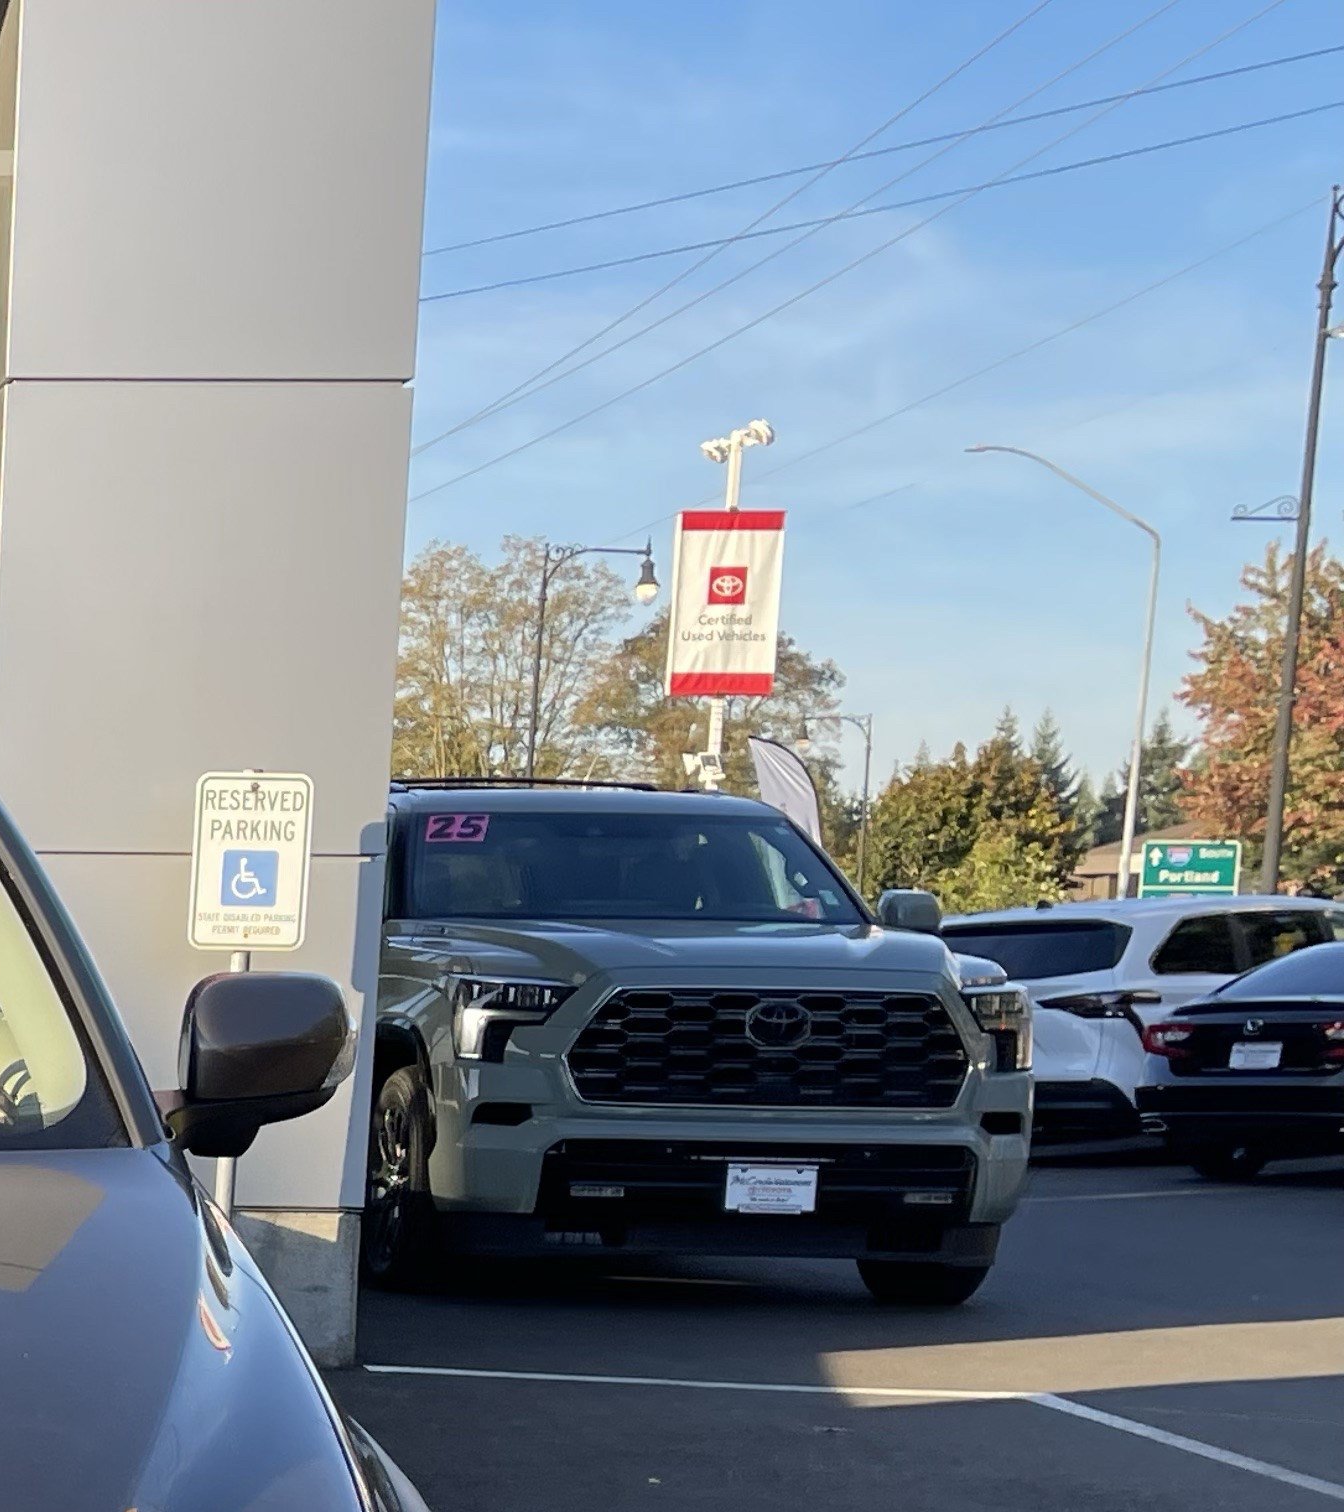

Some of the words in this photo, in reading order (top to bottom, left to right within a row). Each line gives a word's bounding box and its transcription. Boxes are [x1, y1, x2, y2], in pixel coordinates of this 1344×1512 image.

[698, 613, 753, 626] Certified
[681, 630, 714, 641] Used
[717, 630, 767, 642] Vehicles
[204, 789, 305, 812] RESERVED
[210, 819, 296, 842] PARKING
[429, 815, 486, 839] 25
[1159, 869, 1221, 884] Portland
